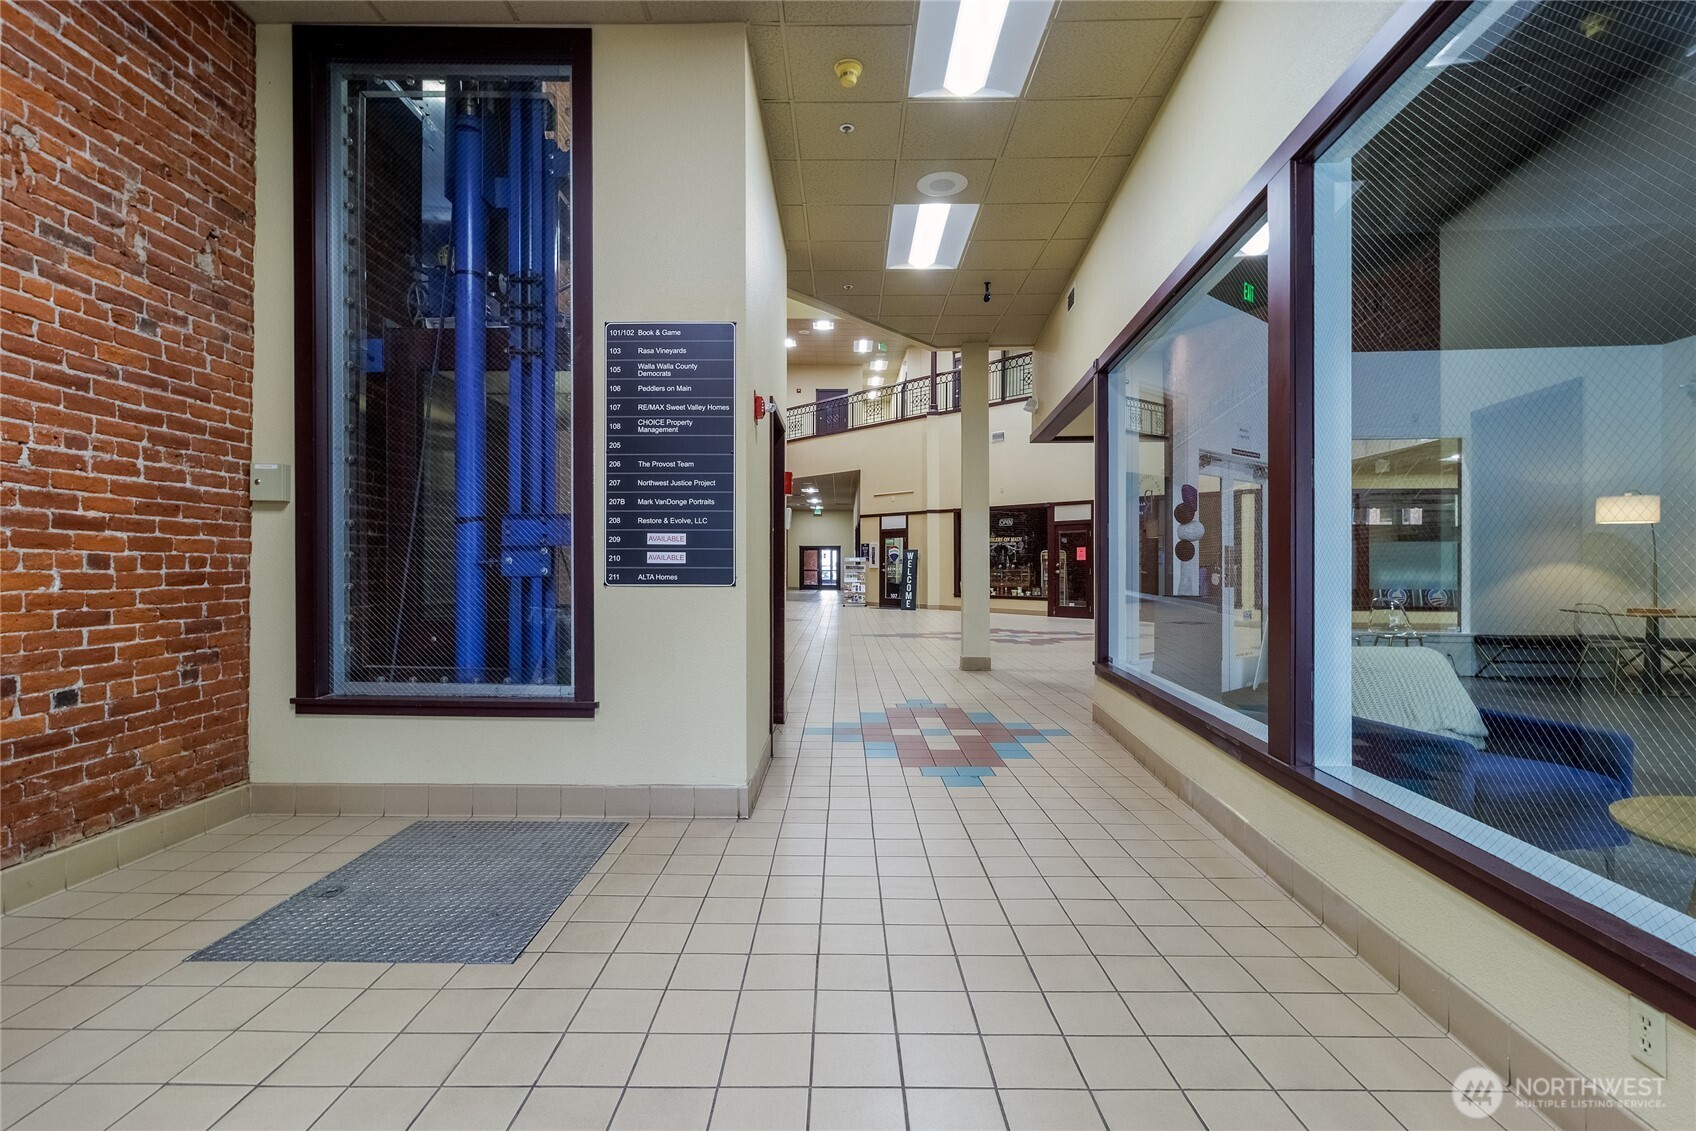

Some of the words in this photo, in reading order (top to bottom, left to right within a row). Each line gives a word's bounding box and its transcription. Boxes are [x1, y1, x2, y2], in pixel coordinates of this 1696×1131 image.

[1243, 281, 1255, 304] EXIT
[687, 404, 706, 412] Valley
[905, 552, 914, 607] WELCOME
